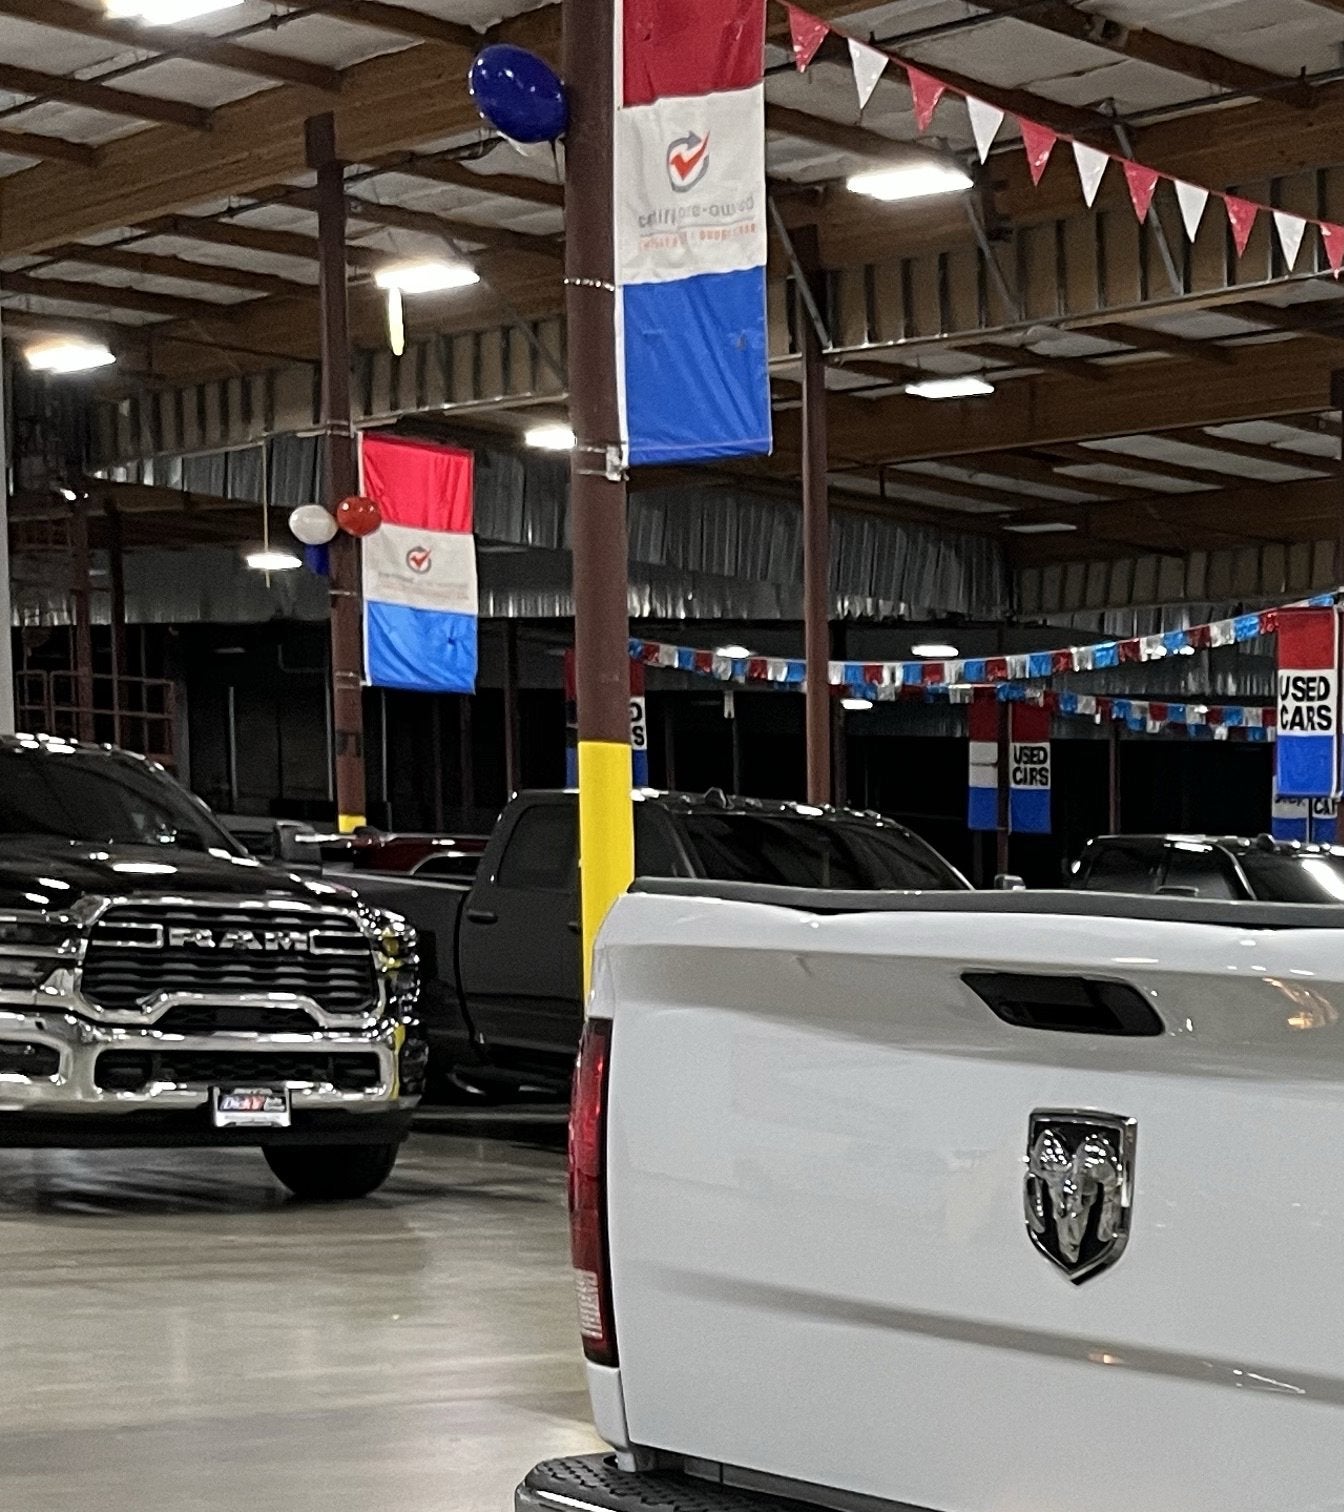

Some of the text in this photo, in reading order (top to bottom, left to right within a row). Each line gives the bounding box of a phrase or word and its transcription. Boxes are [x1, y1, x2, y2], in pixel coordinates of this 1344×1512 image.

[1280, 675, 1330, 702] USED
[1280, 704, 1332, 731] CARS
[1014, 745, 1048, 765] USED
[168, 928, 308, 951] RAM
